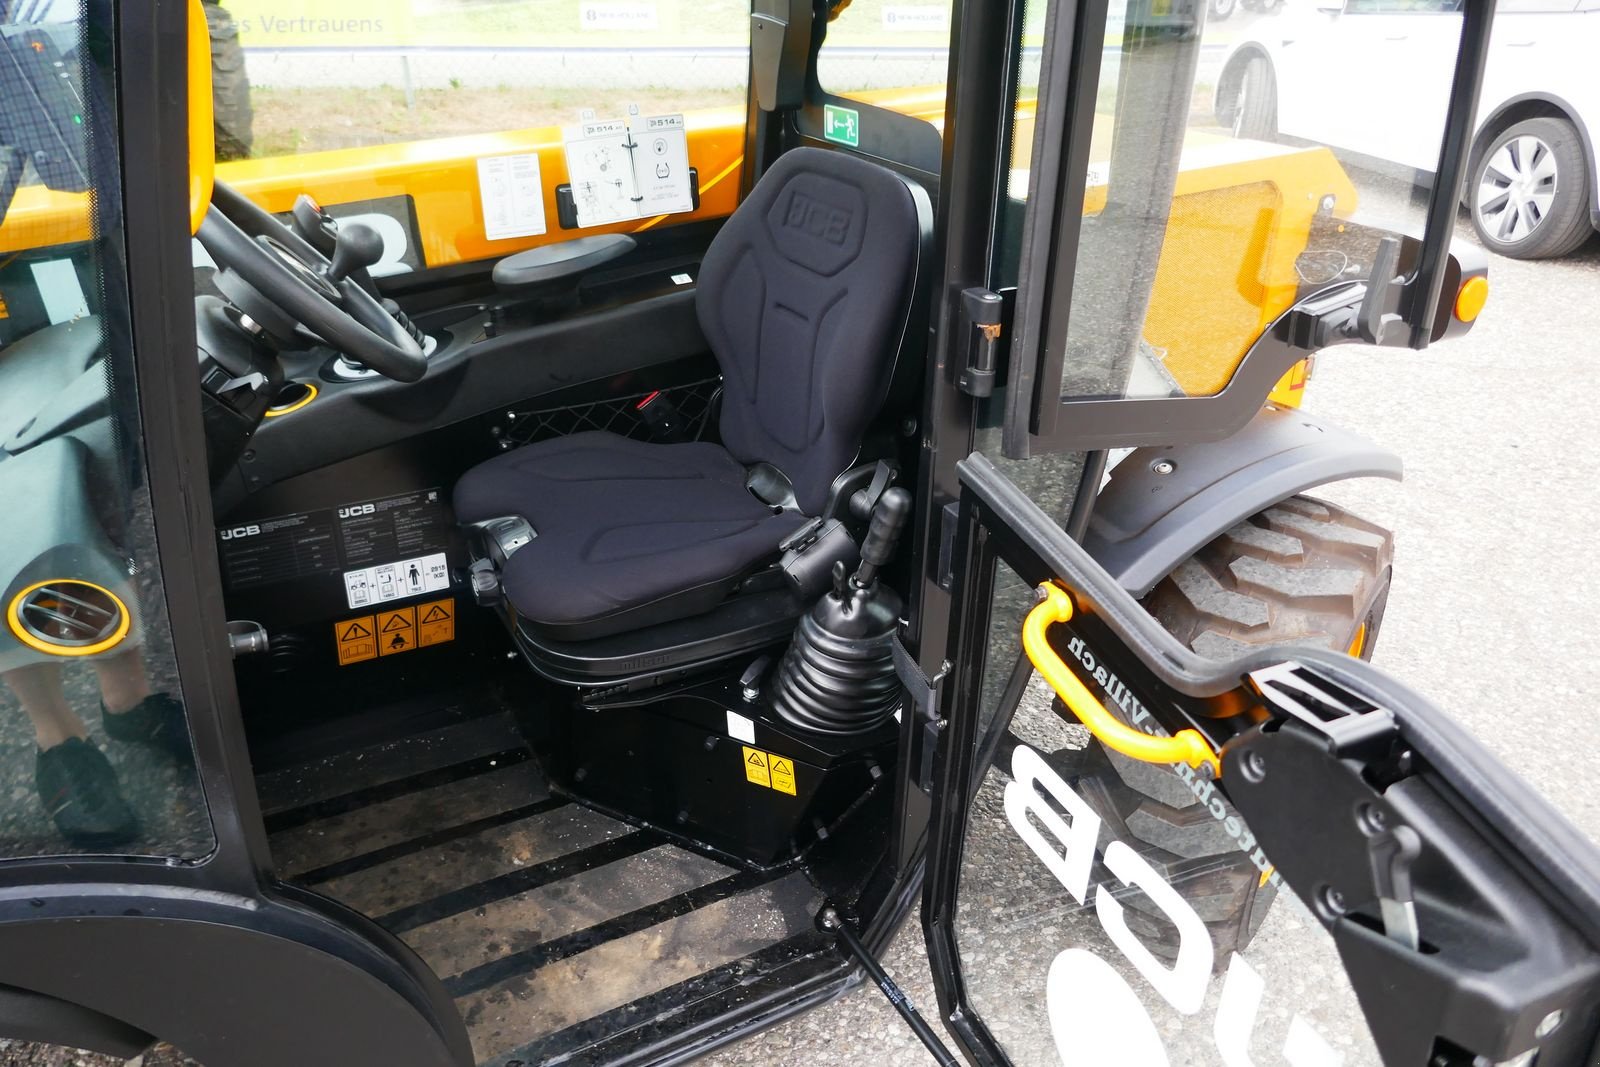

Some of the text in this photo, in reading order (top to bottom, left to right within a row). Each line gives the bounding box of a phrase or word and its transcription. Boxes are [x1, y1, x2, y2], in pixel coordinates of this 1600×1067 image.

[260, 15, 384, 33] Vertrauens
[657, 118, 675, 127] 514
[781, 190, 854, 247] JCB
[339, 503, 376, 519] JCB
[220, 524, 261, 541] JCB
